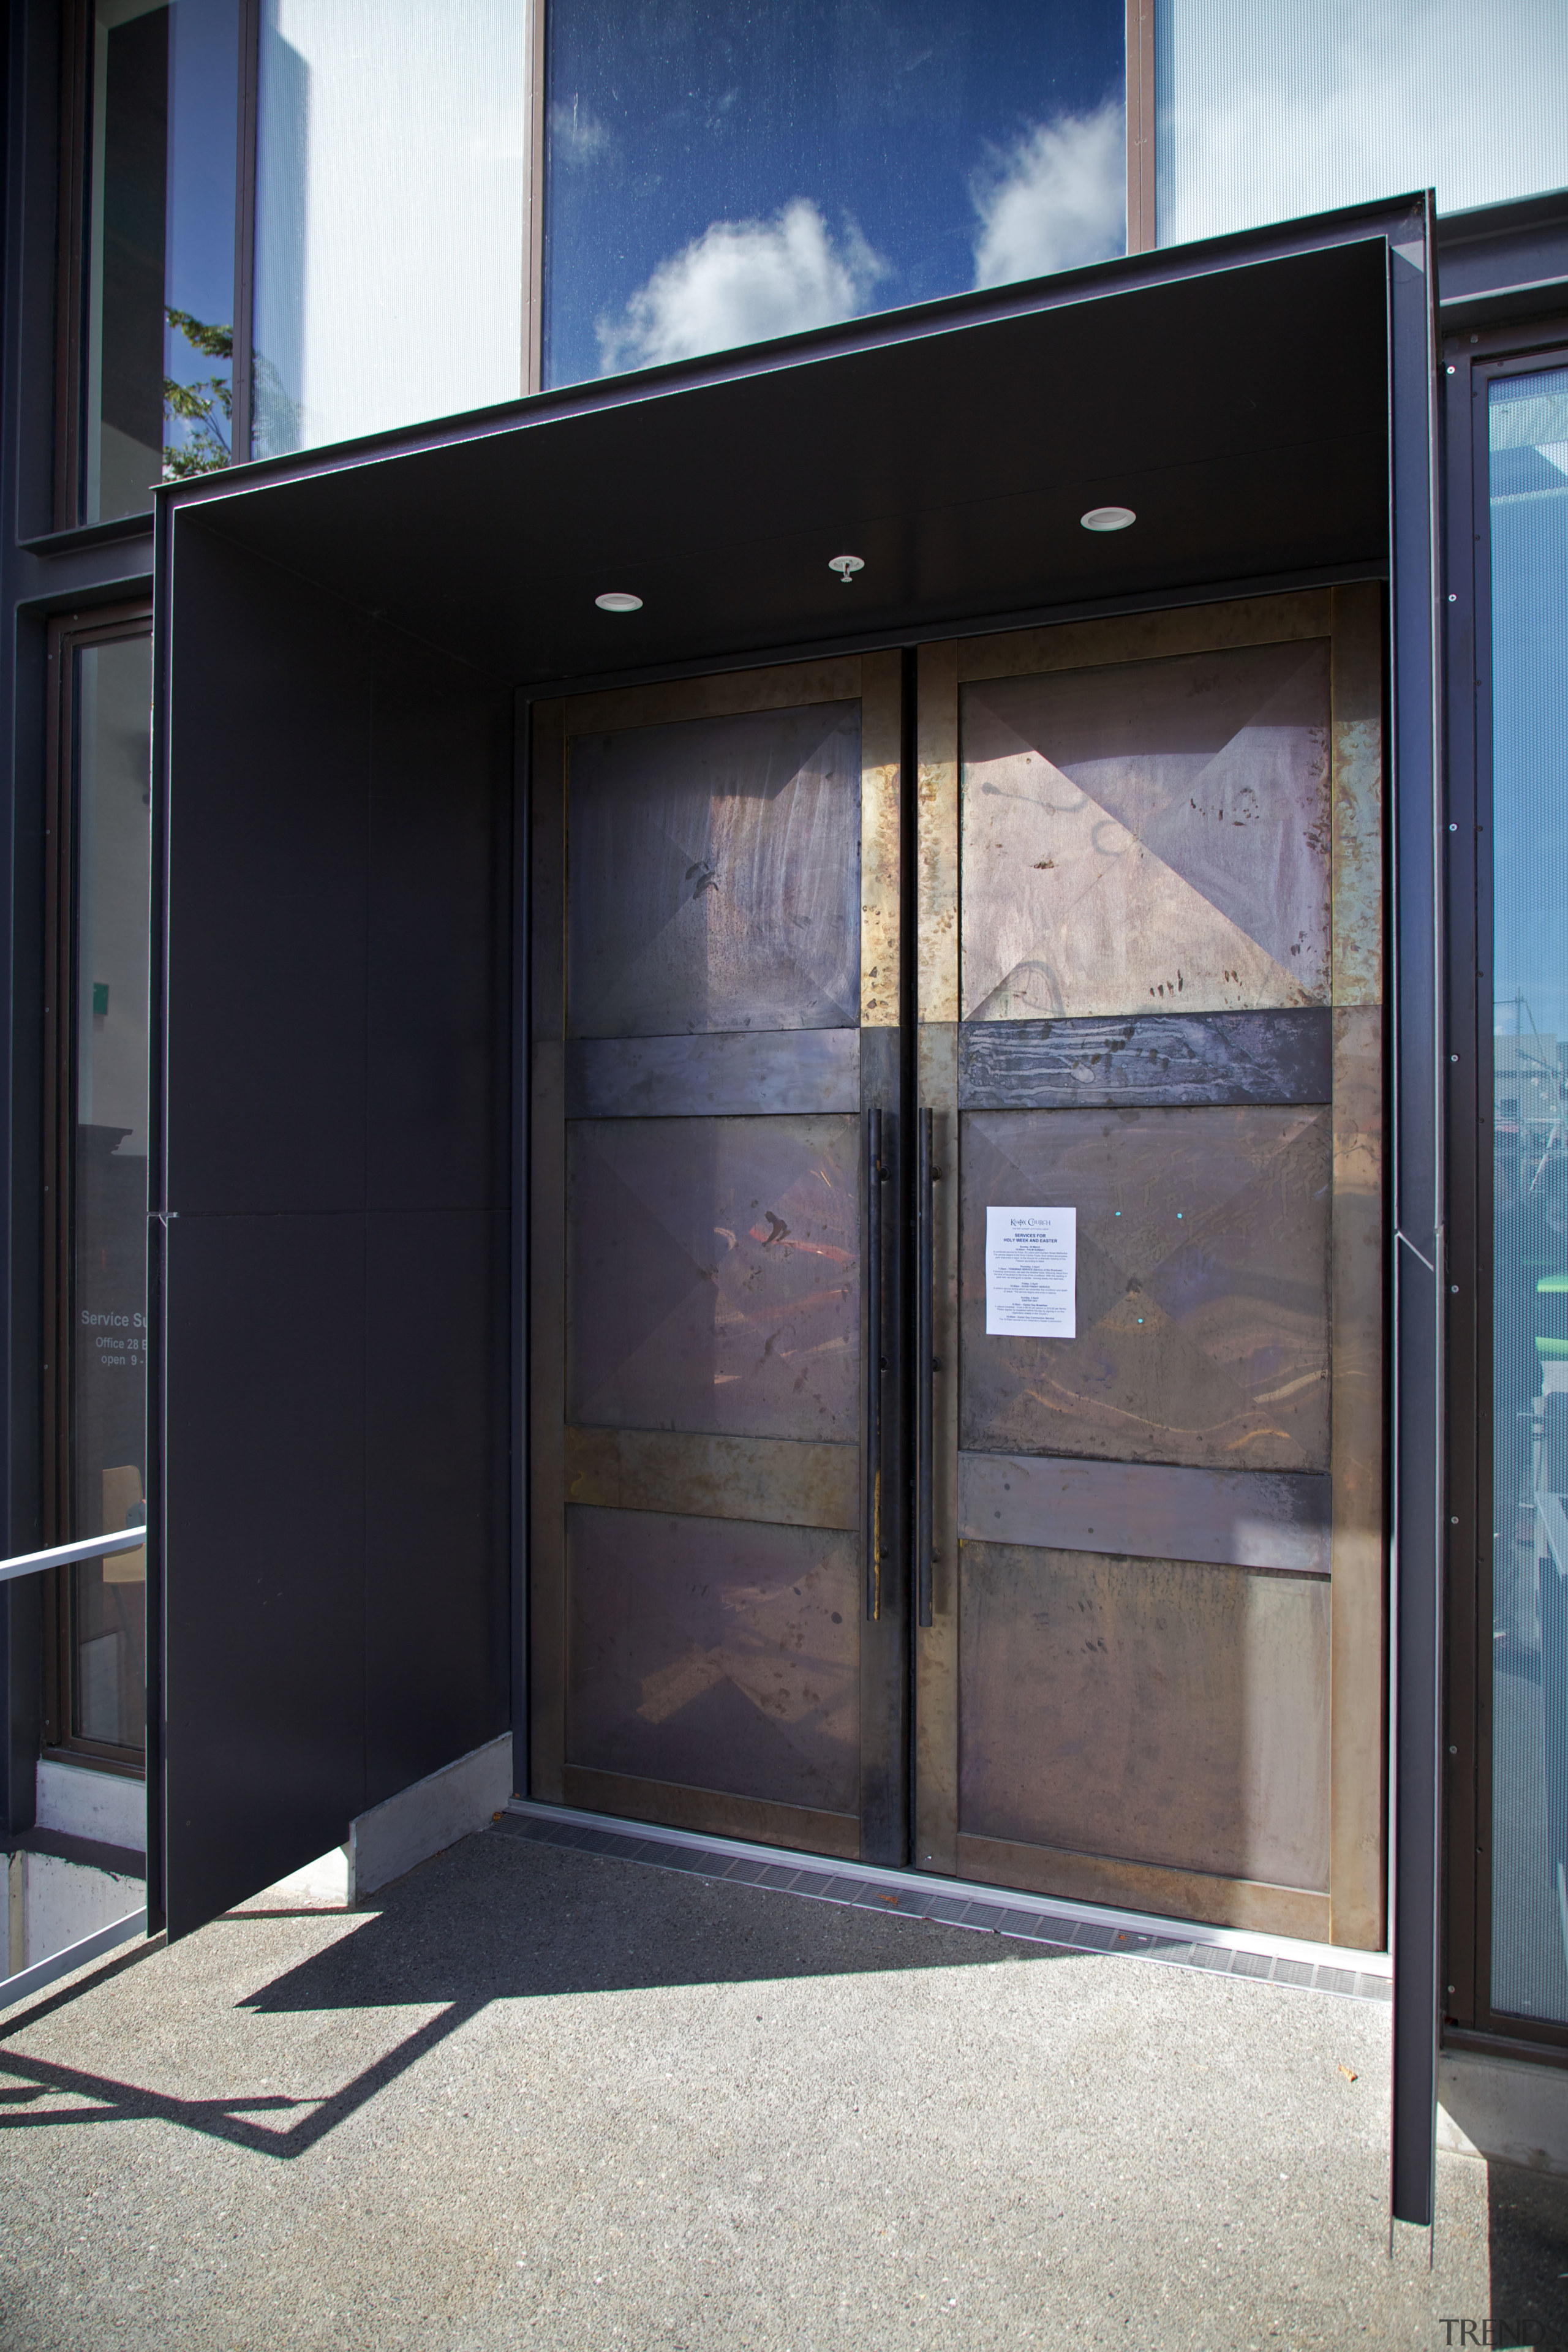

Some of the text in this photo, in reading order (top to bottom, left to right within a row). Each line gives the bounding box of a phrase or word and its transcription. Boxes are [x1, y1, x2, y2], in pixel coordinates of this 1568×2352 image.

[81, 1310, 129, 1327] Service
[96, 1336, 125, 1349] Office
[127, 1339, 139, 1350] 28
[101, 1355, 126, 1366] open
[131, 1355, 137, 1366] 9
